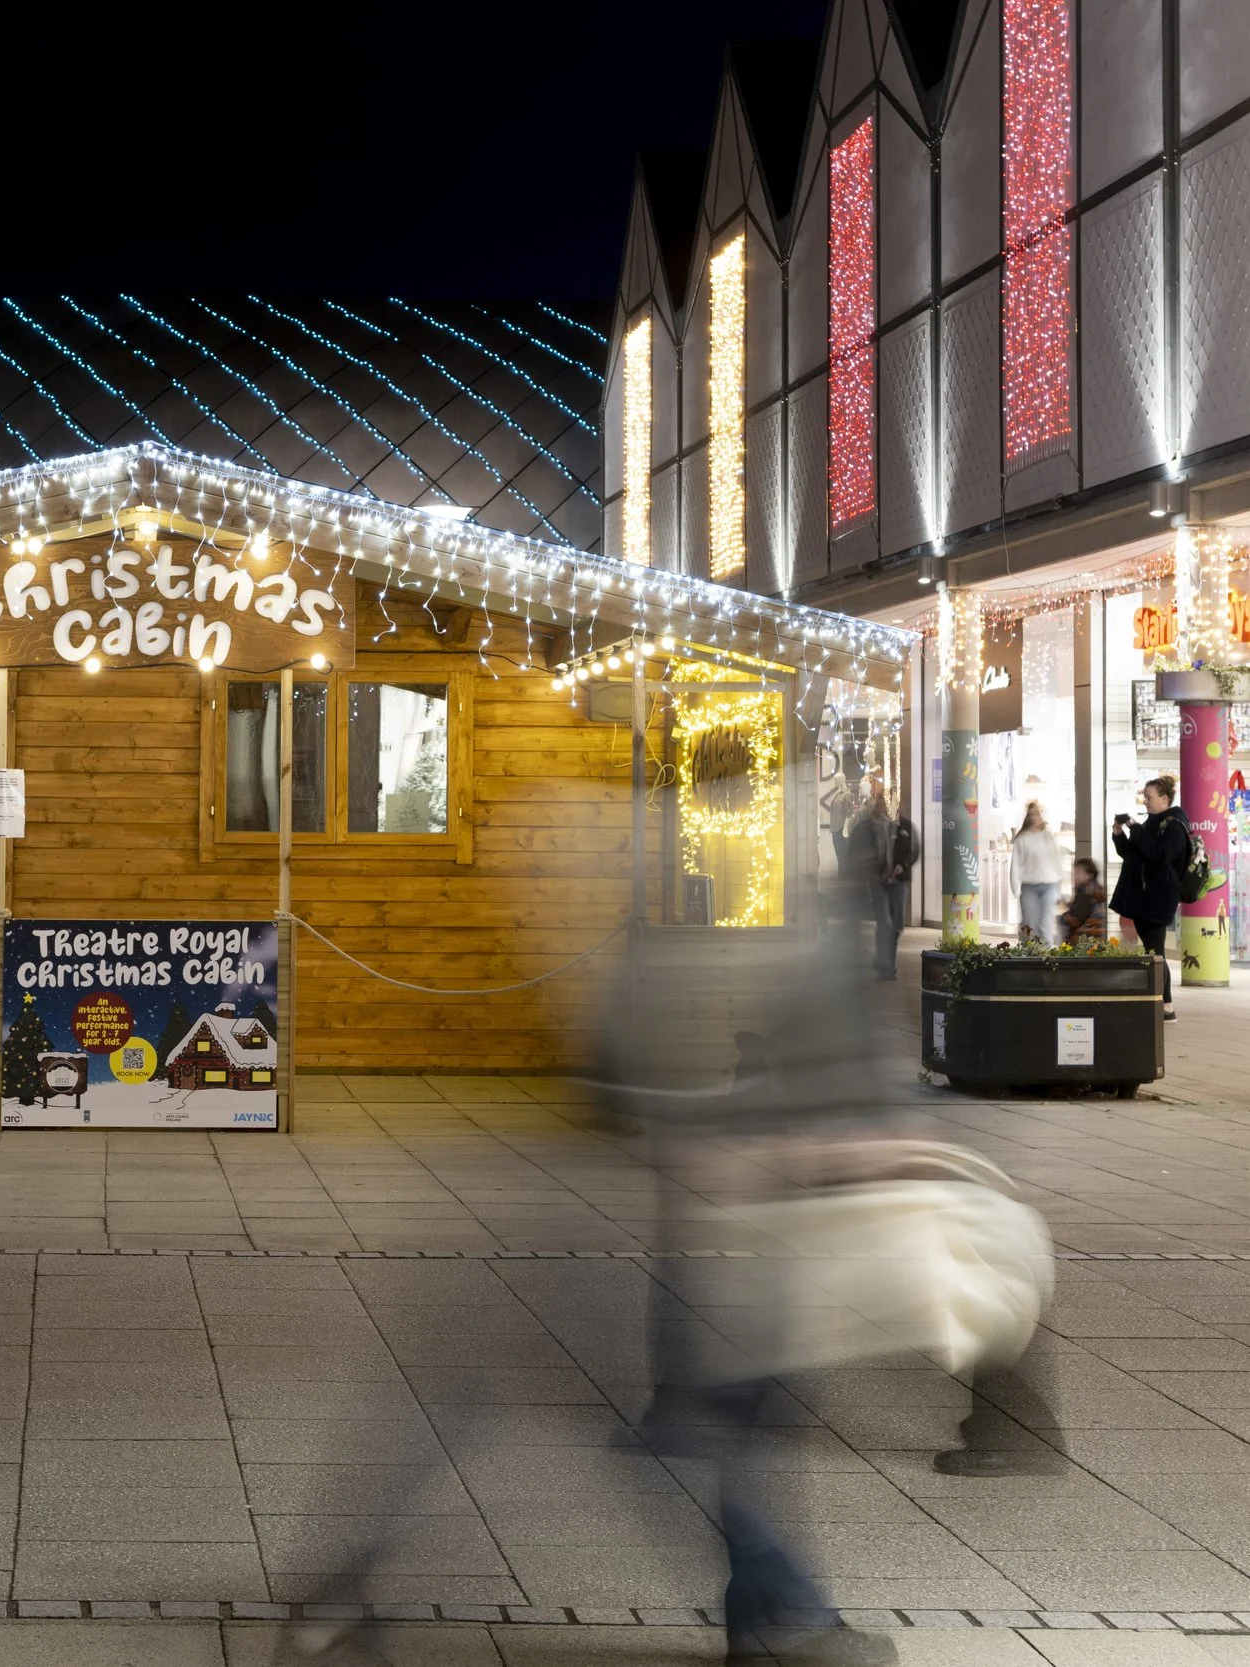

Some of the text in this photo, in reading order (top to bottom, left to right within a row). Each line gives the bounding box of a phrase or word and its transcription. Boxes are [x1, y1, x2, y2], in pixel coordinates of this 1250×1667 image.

[32, 927, 250, 961] Theatre Royal
[16, 957, 265, 988] Christmas Cabin
[97, 998, 109, 1006] An
[76, 1022, 129, 1031] performance
[86, 1030, 100, 1038] for
[83, 1038, 102, 1047] year
[3, 1115, 21, 1123] arc
